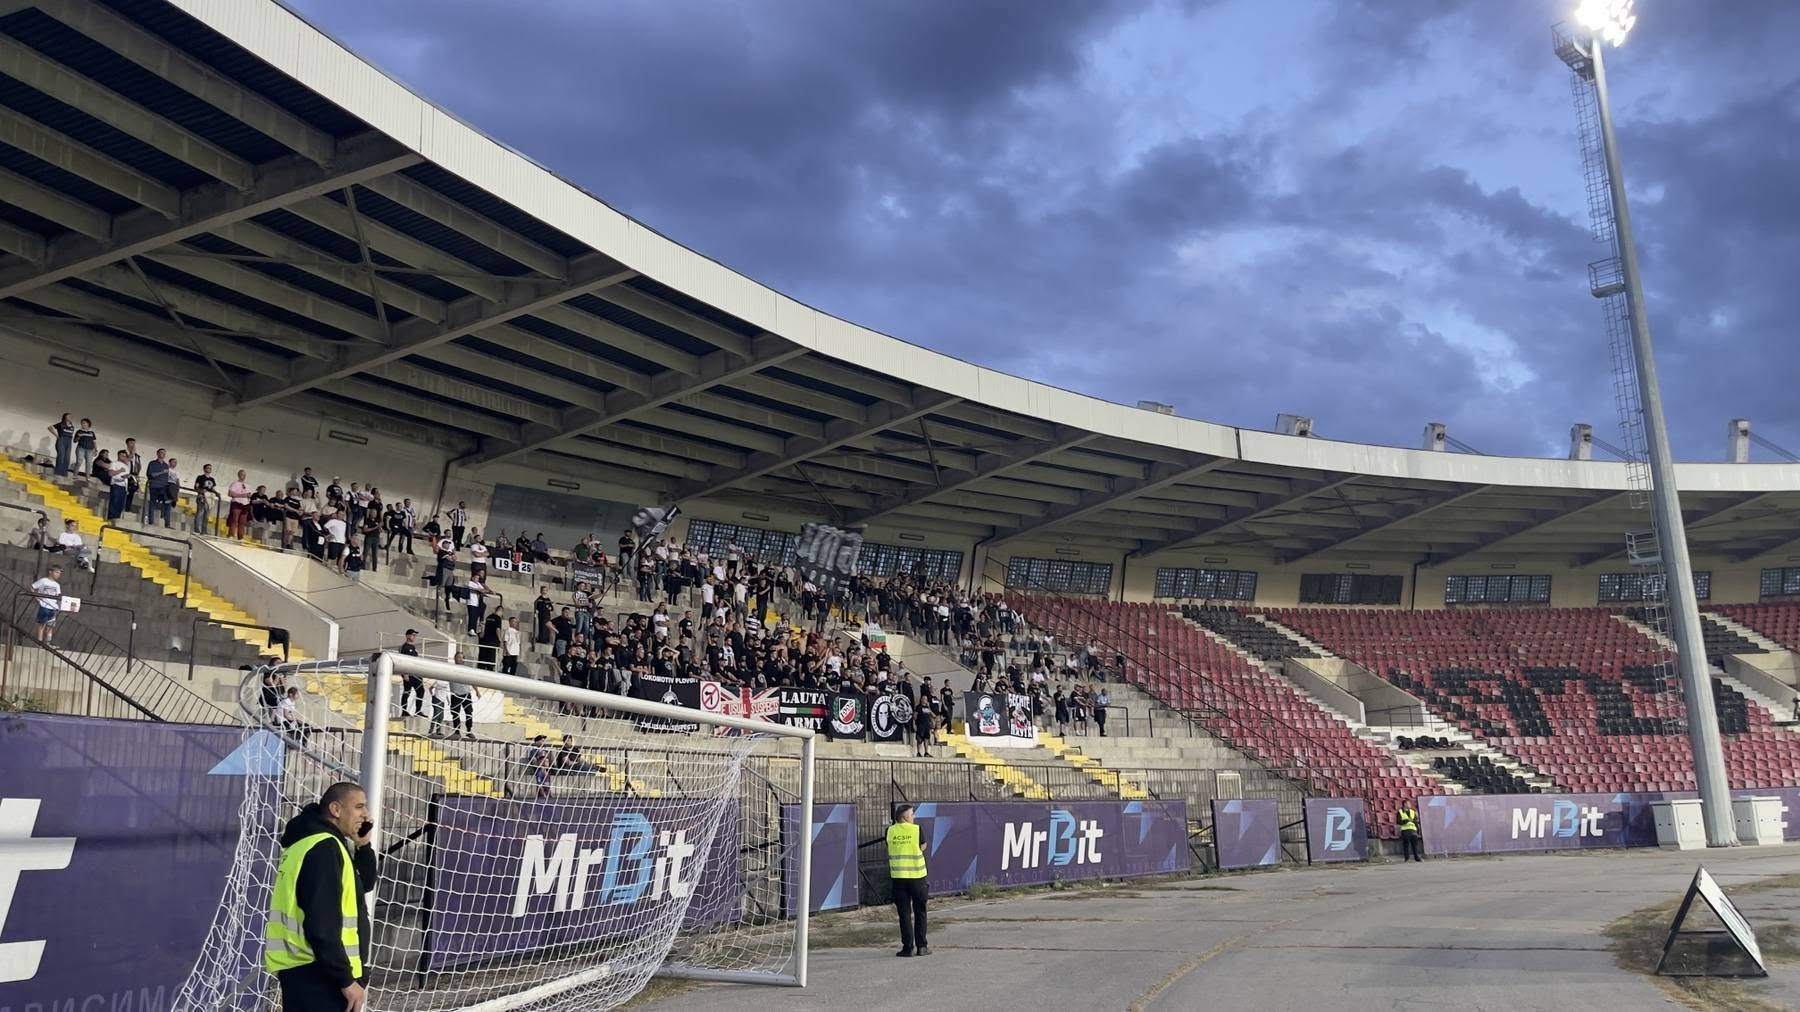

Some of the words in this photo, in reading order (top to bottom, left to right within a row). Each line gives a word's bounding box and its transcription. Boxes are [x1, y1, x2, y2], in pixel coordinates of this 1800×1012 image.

[499, 559, 509, 569] 19
[781, 691, 826, 706] LAUTA
[784, 717, 824, 730] ARMY
[1512, 799, 1604, 840] MrBit
[1001, 809, 1104, 871] MrBit
[512, 812, 695, 918] MrBit
